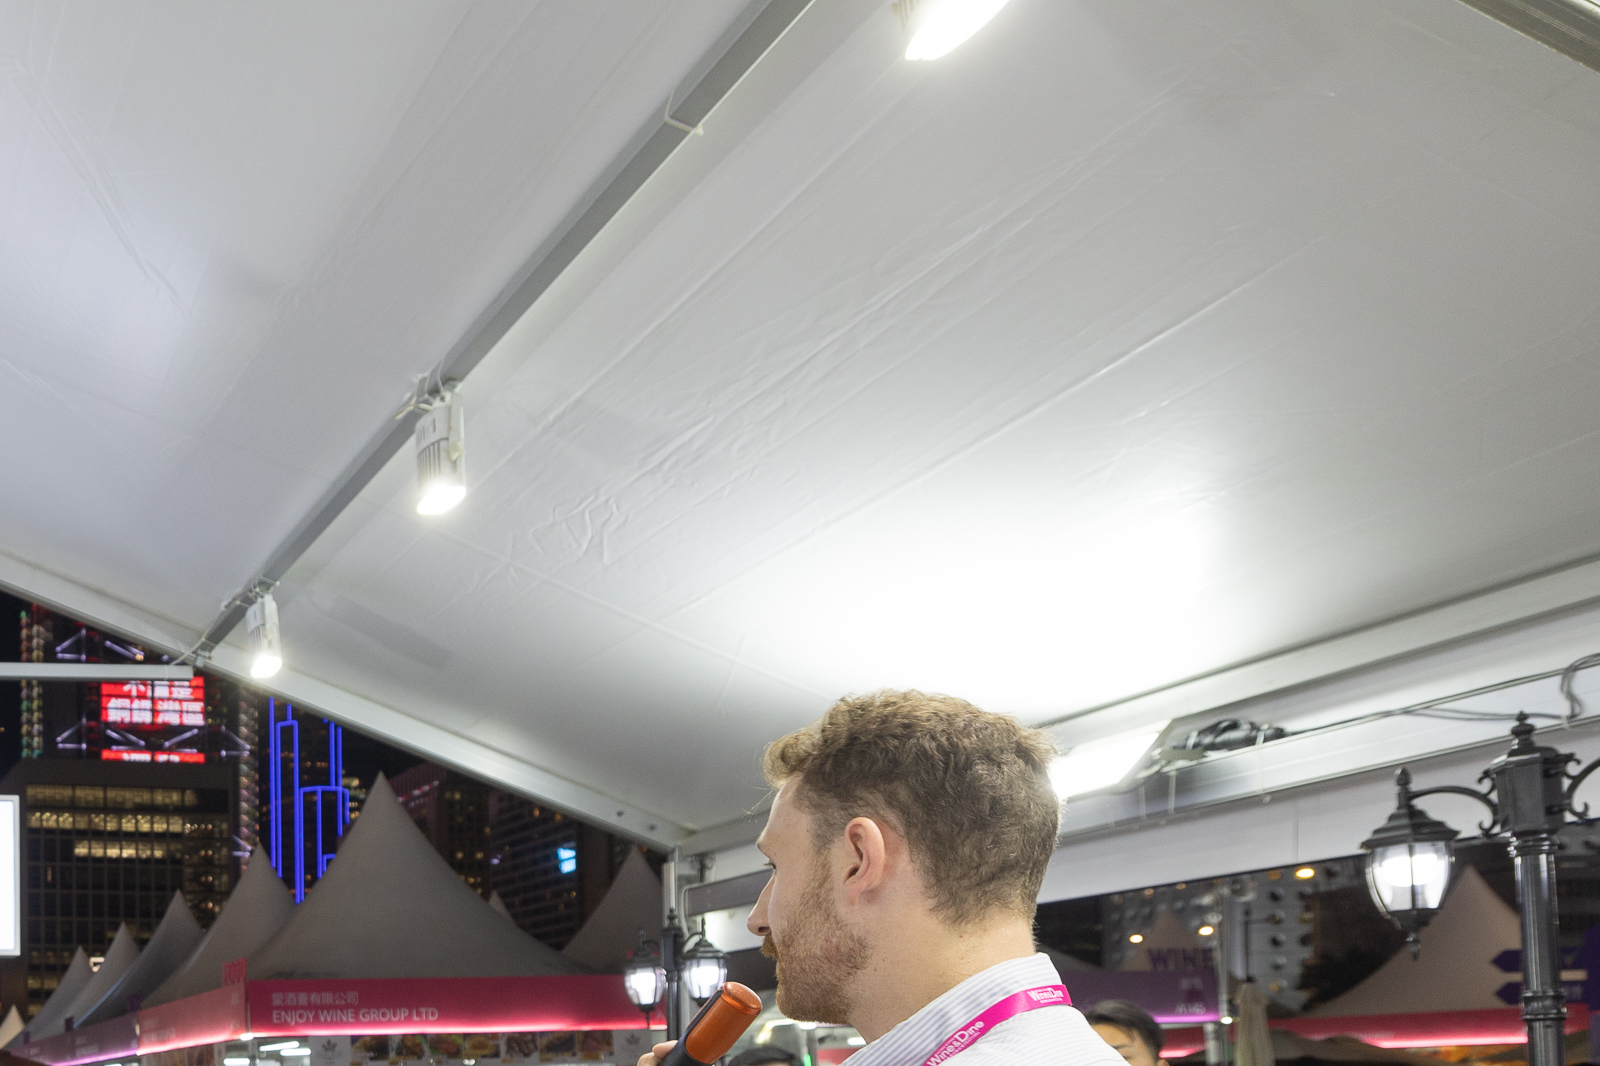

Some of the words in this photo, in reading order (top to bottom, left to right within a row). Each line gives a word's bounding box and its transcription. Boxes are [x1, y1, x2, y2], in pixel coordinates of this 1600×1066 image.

[273, 1009, 315, 1025] ENJOY
[318, 1009, 356, 1022] WINE
[359, 1008, 409, 1022] GROUP
[412, 1007, 439, 1021] LTD
[927, 1021, 985, 1066] Wine&Dine
